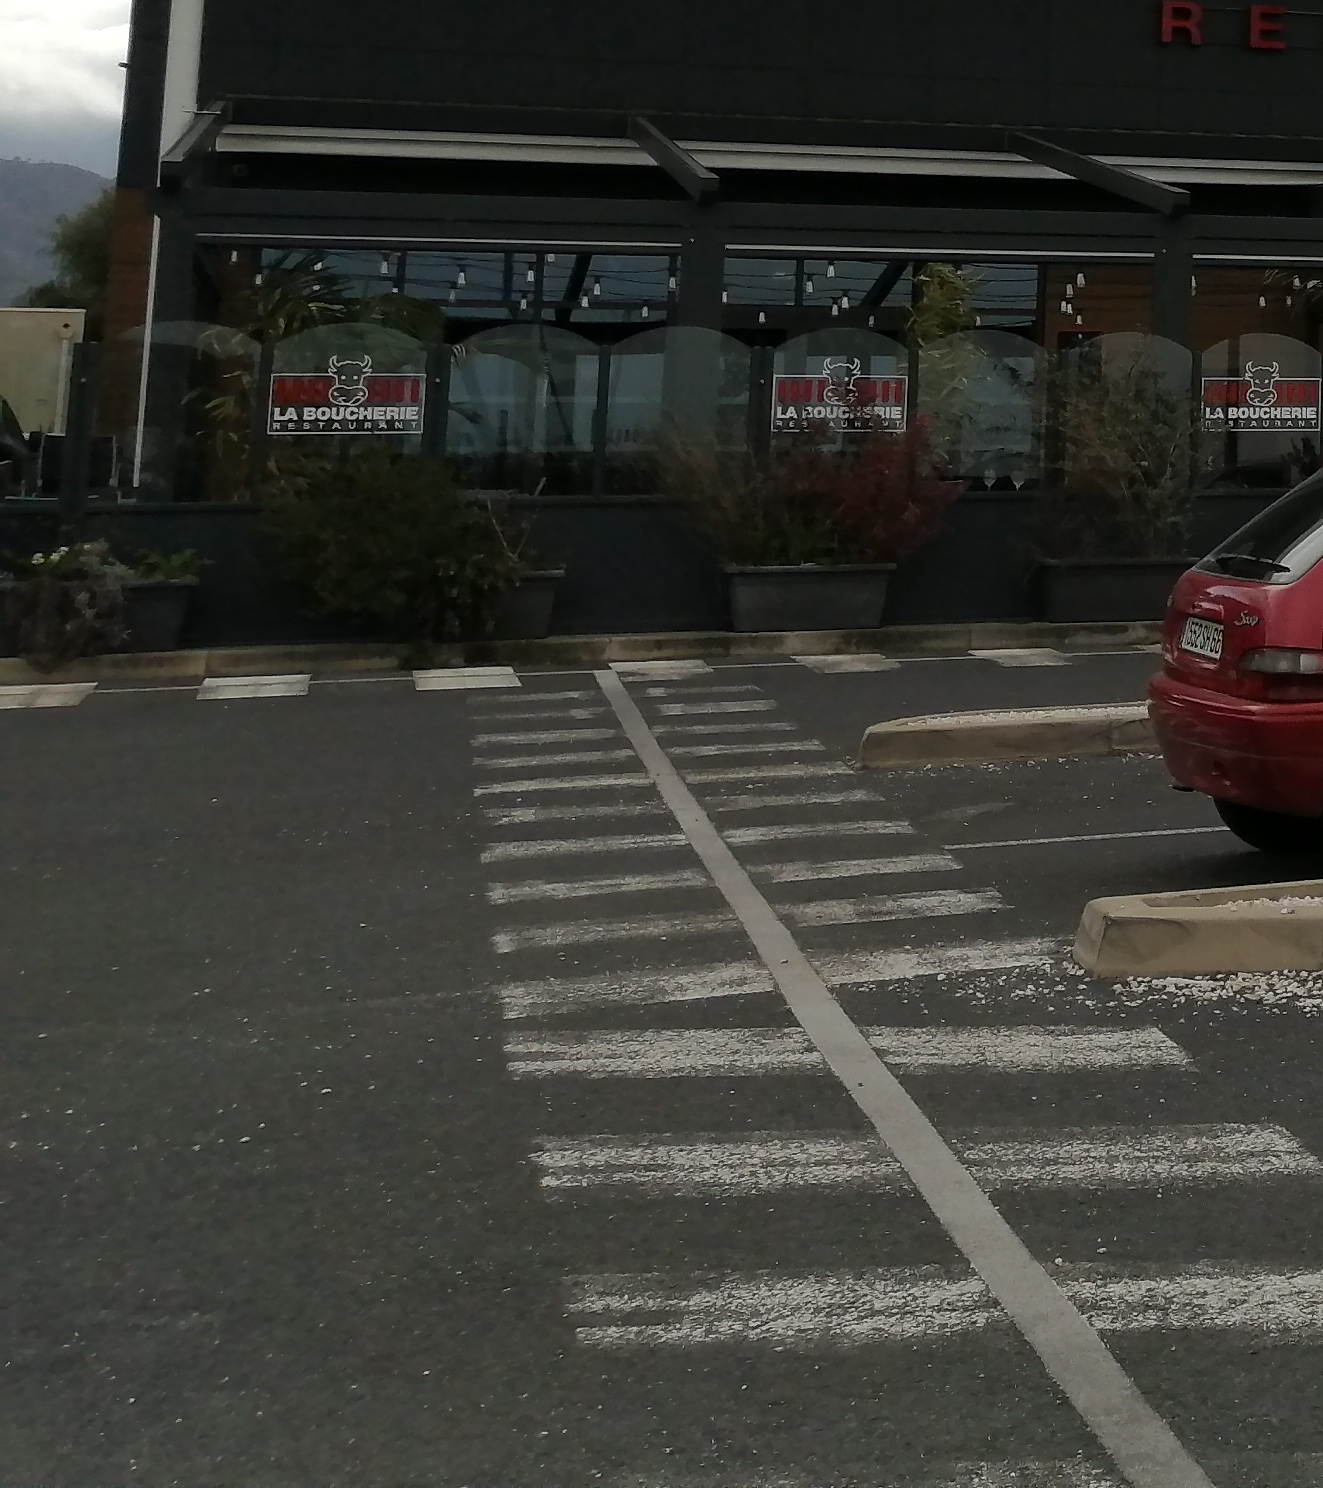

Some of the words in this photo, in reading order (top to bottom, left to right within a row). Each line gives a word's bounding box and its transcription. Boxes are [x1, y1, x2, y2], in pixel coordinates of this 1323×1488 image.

[273, 407, 299, 420] LA
[303, 407, 419, 420] BOUCHERIE
[777, 406, 798, 419] LA
[1205, 407, 1225, 419] LA
[1228, 407, 1317, 419] BOUCHERIE
[273, 421, 418, 430] RESTAURANT
